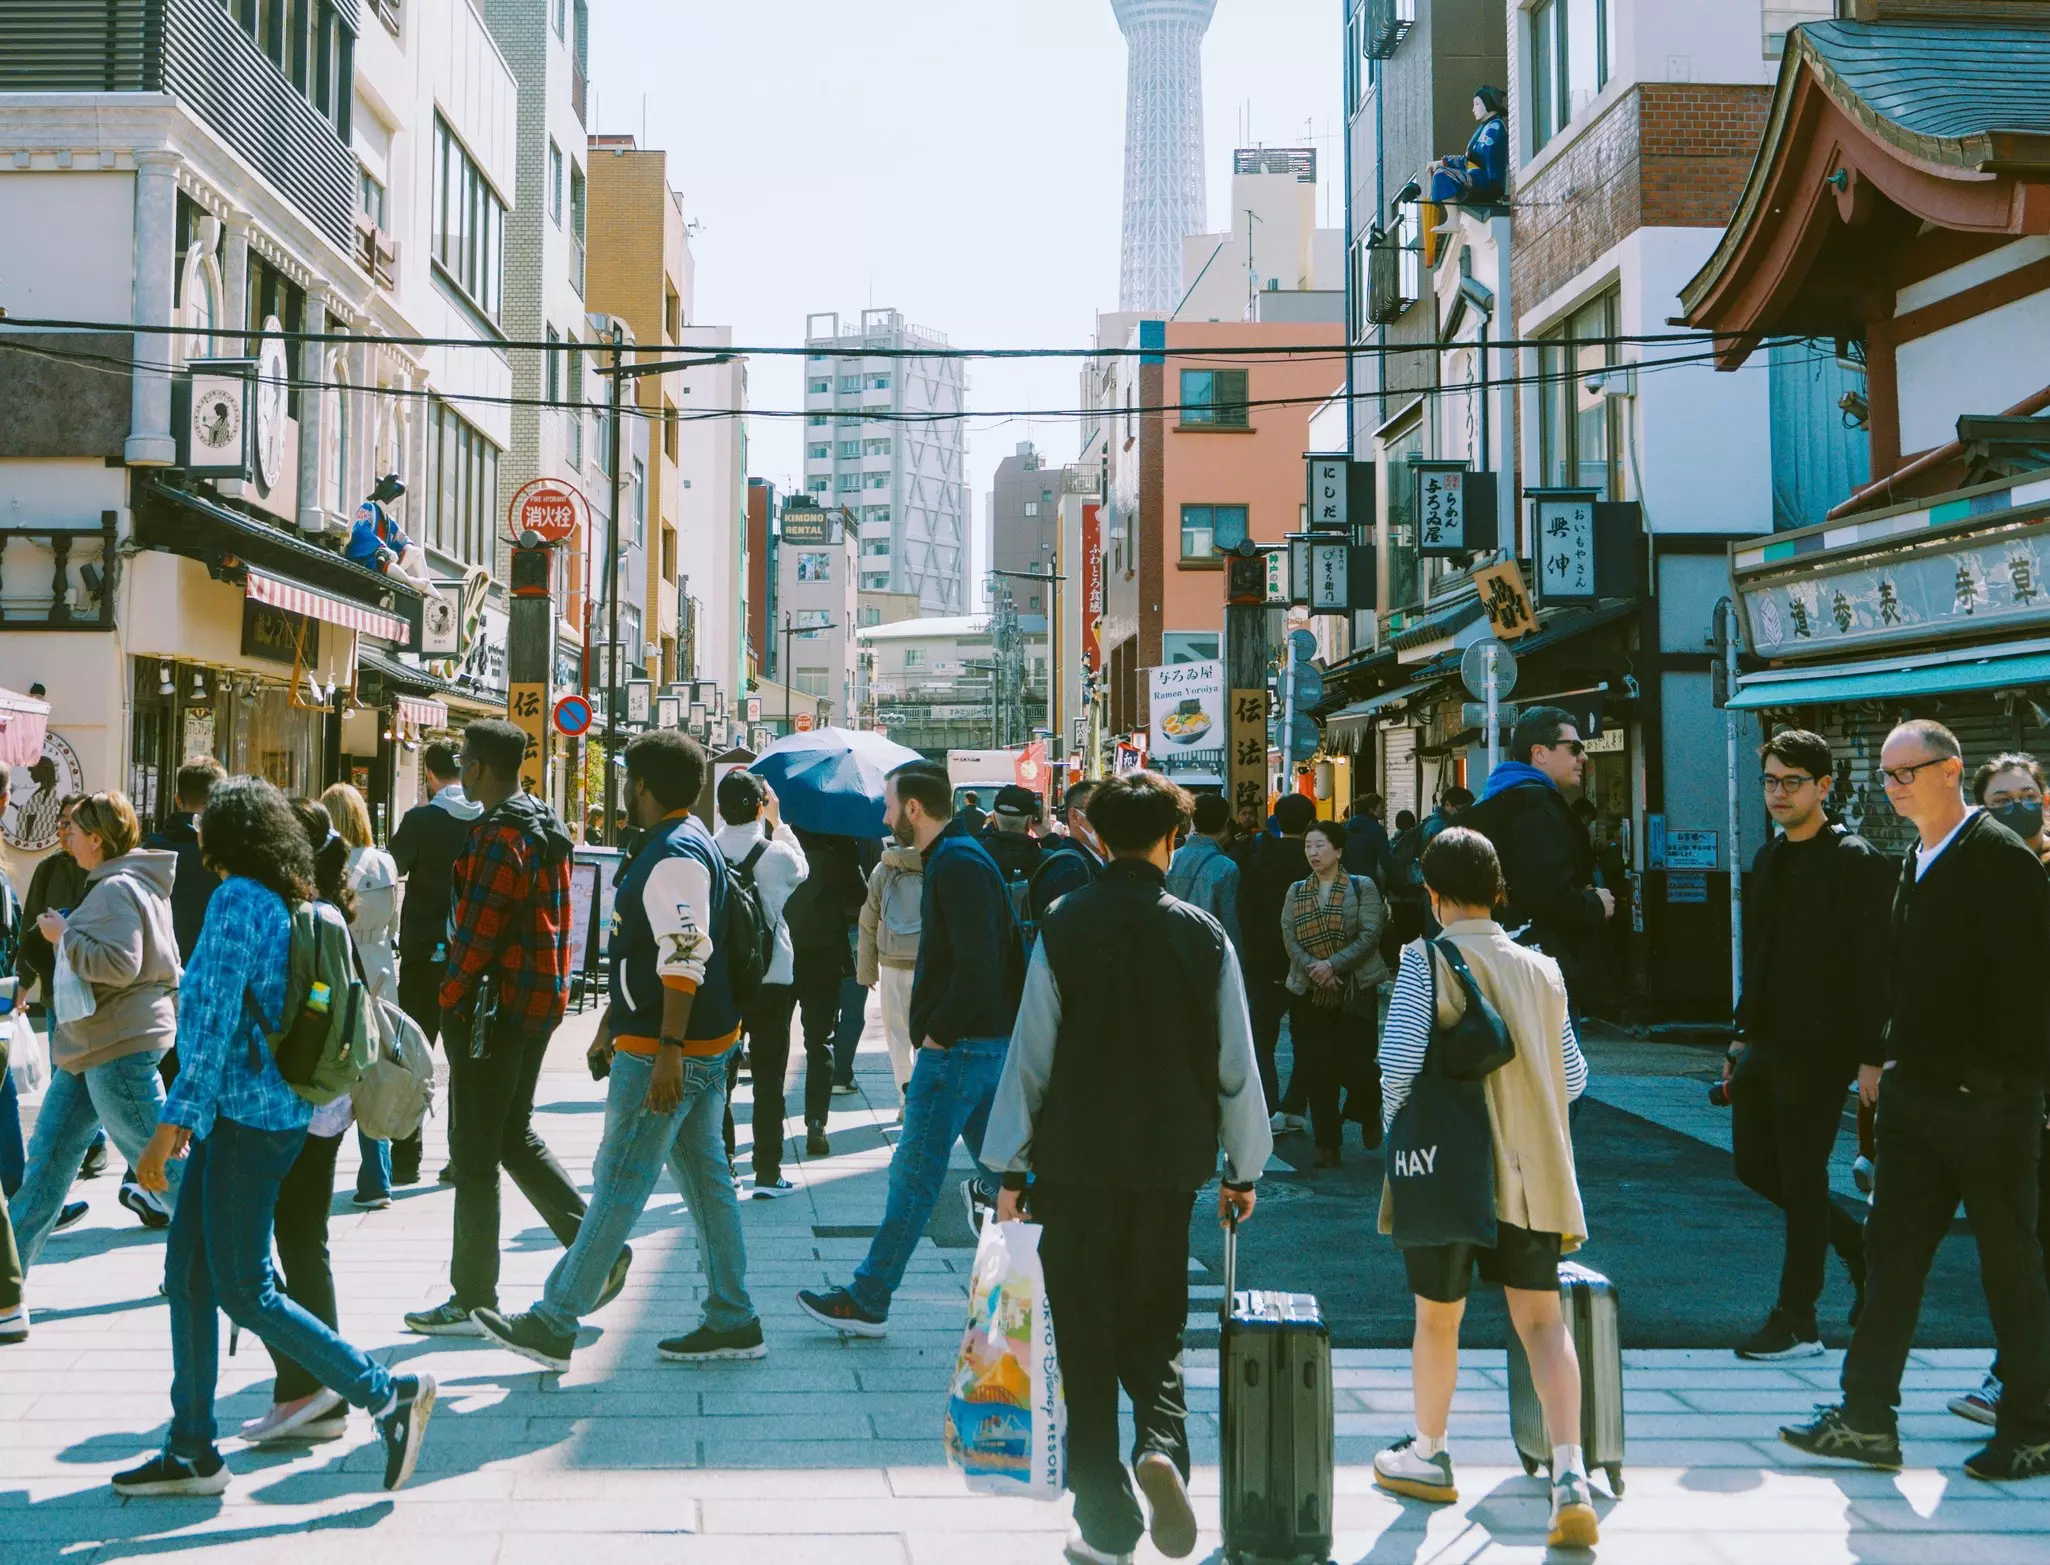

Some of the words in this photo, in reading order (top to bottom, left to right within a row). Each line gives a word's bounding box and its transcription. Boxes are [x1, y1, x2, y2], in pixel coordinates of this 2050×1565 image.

[1323, 467, 1336, 518] にしだ
[526, 506, 571, 527] 消火栓
[784, 513, 824, 522] KIMONO
[785, 525, 823, 534] RENTAL
[1574, 509, 1586, 588] おいもやさん
[1089, 544, 1100, 613] ふわとろ食感
[1159, 665, 1213, 685] 与ろゐ屋
[1154, 689, 1182, 700] Ramen
[1185, 685, 1218, 696] Yoroiya
[1395, 1145, 1437, 1177] HAY
[1040, 1351, 1059, 1418] Disney
[1047, 1423, 1057, 1487] RESORT
